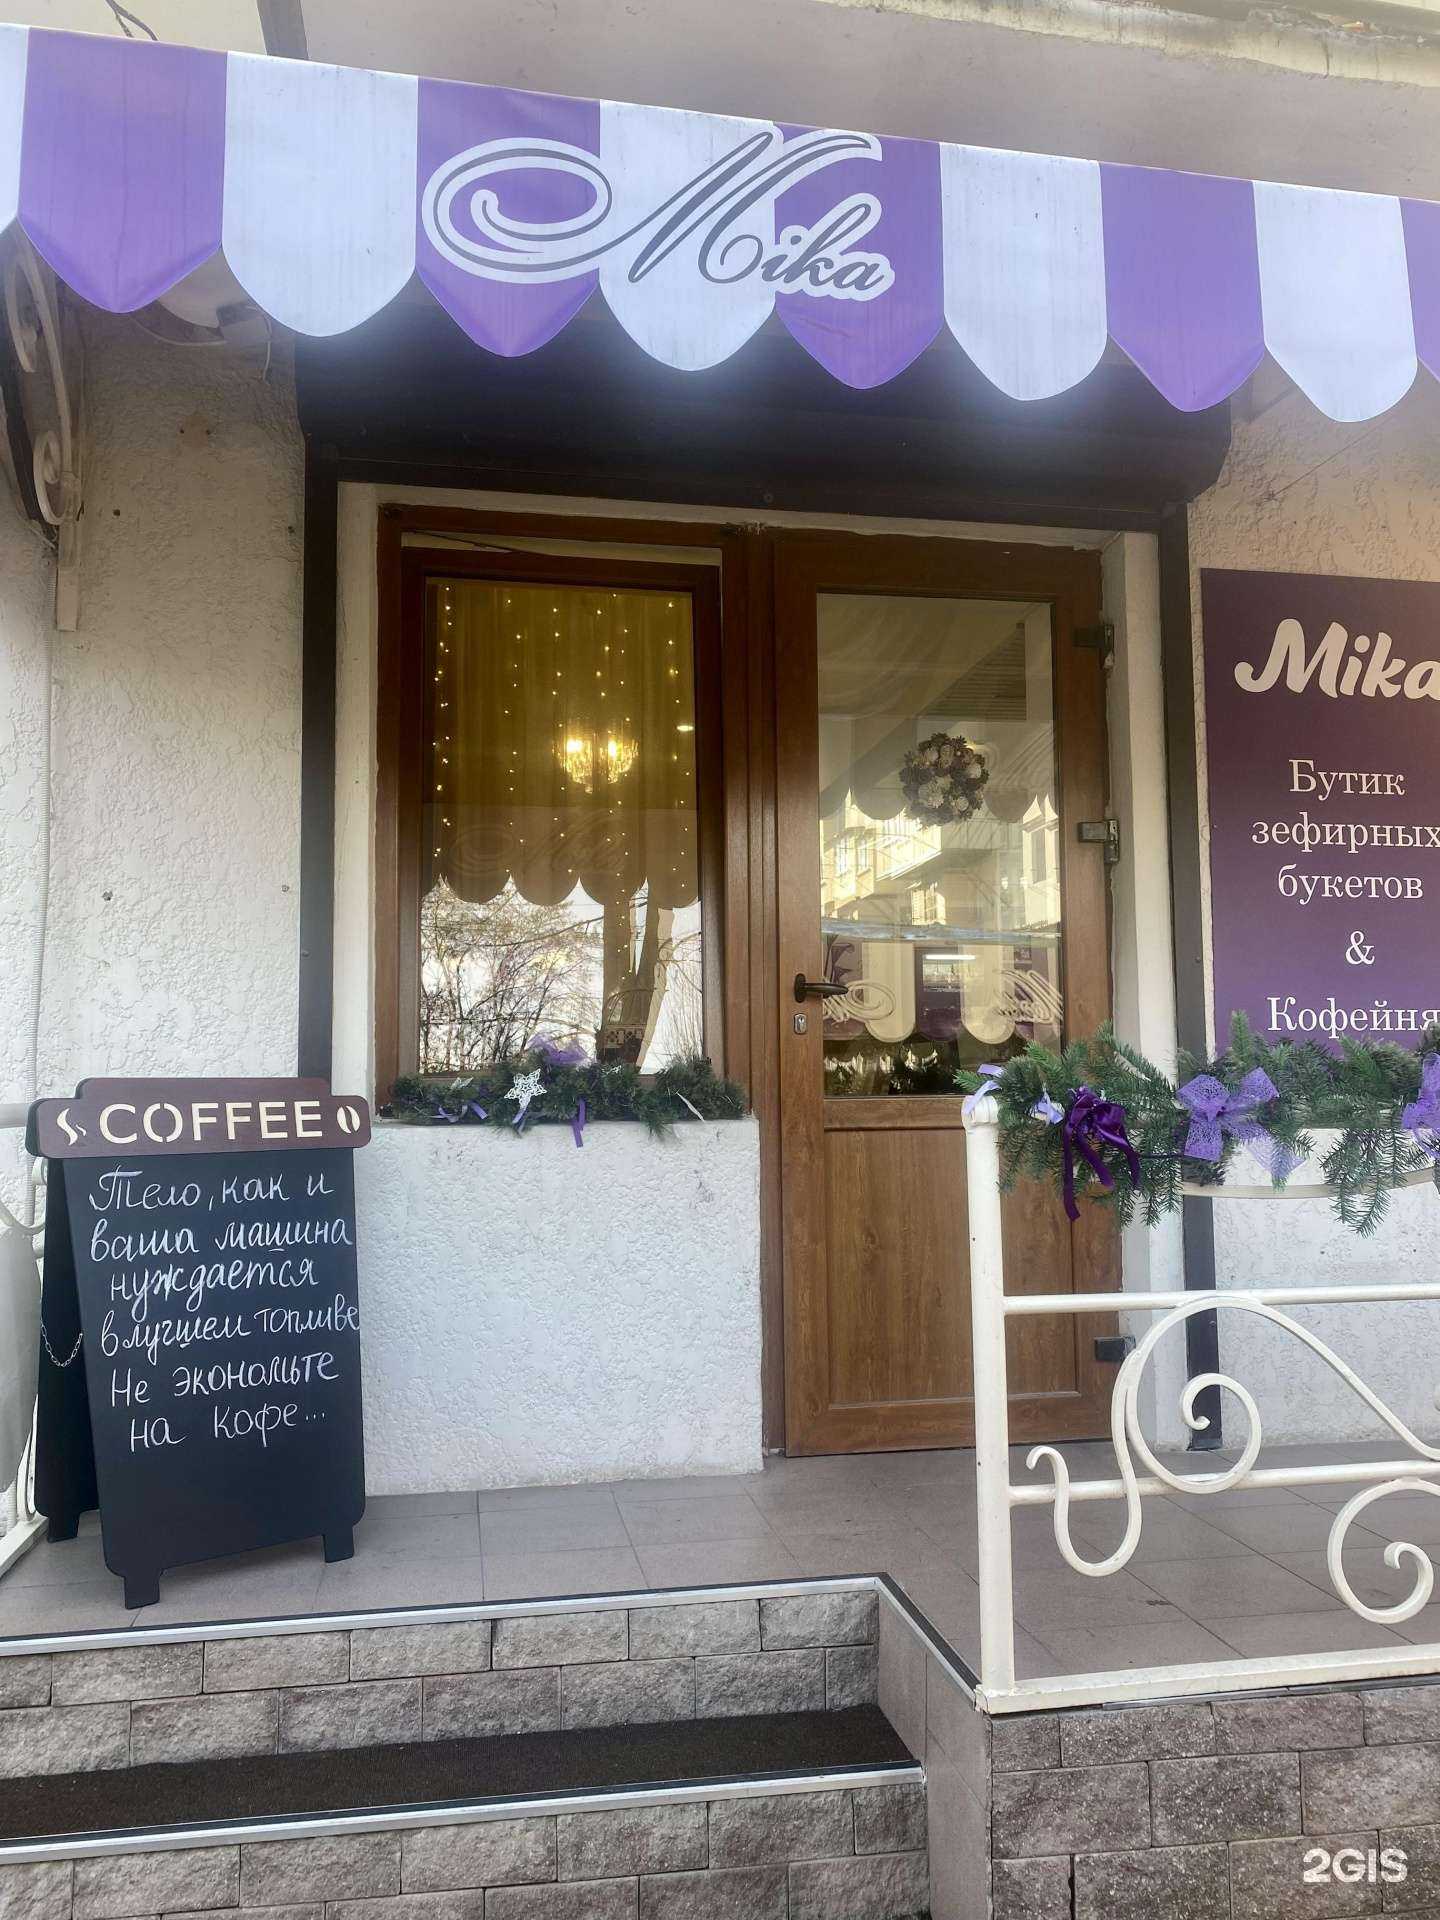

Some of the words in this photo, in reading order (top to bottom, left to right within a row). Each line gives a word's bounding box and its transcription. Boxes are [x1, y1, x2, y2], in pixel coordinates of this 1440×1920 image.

[422, 128, 895, 301] Mika
[1234, 617, 1440, 700] Mika
[1289, 759, 1406, 801] Бутик
[1277, 863, 1424, 905] букетов
[1345, 930, 1376, 966] &
[1266, 996, 1440, 1038] Кофейня
[99, 1100, 323, 1144] COFFEE
[221, 1173, 291, 1205] как
[306, 1172, 335, 1197] и
[90, 1217, 200, 1262] ваша
[214, 1216, 354, 1252] машина
[110, 1257, 320, 1323] нуждается
[253, 1293, 360, 1336] топливе
[111, 1368, 151, 1408] Не
[130, 1417, 187, 1453] на
